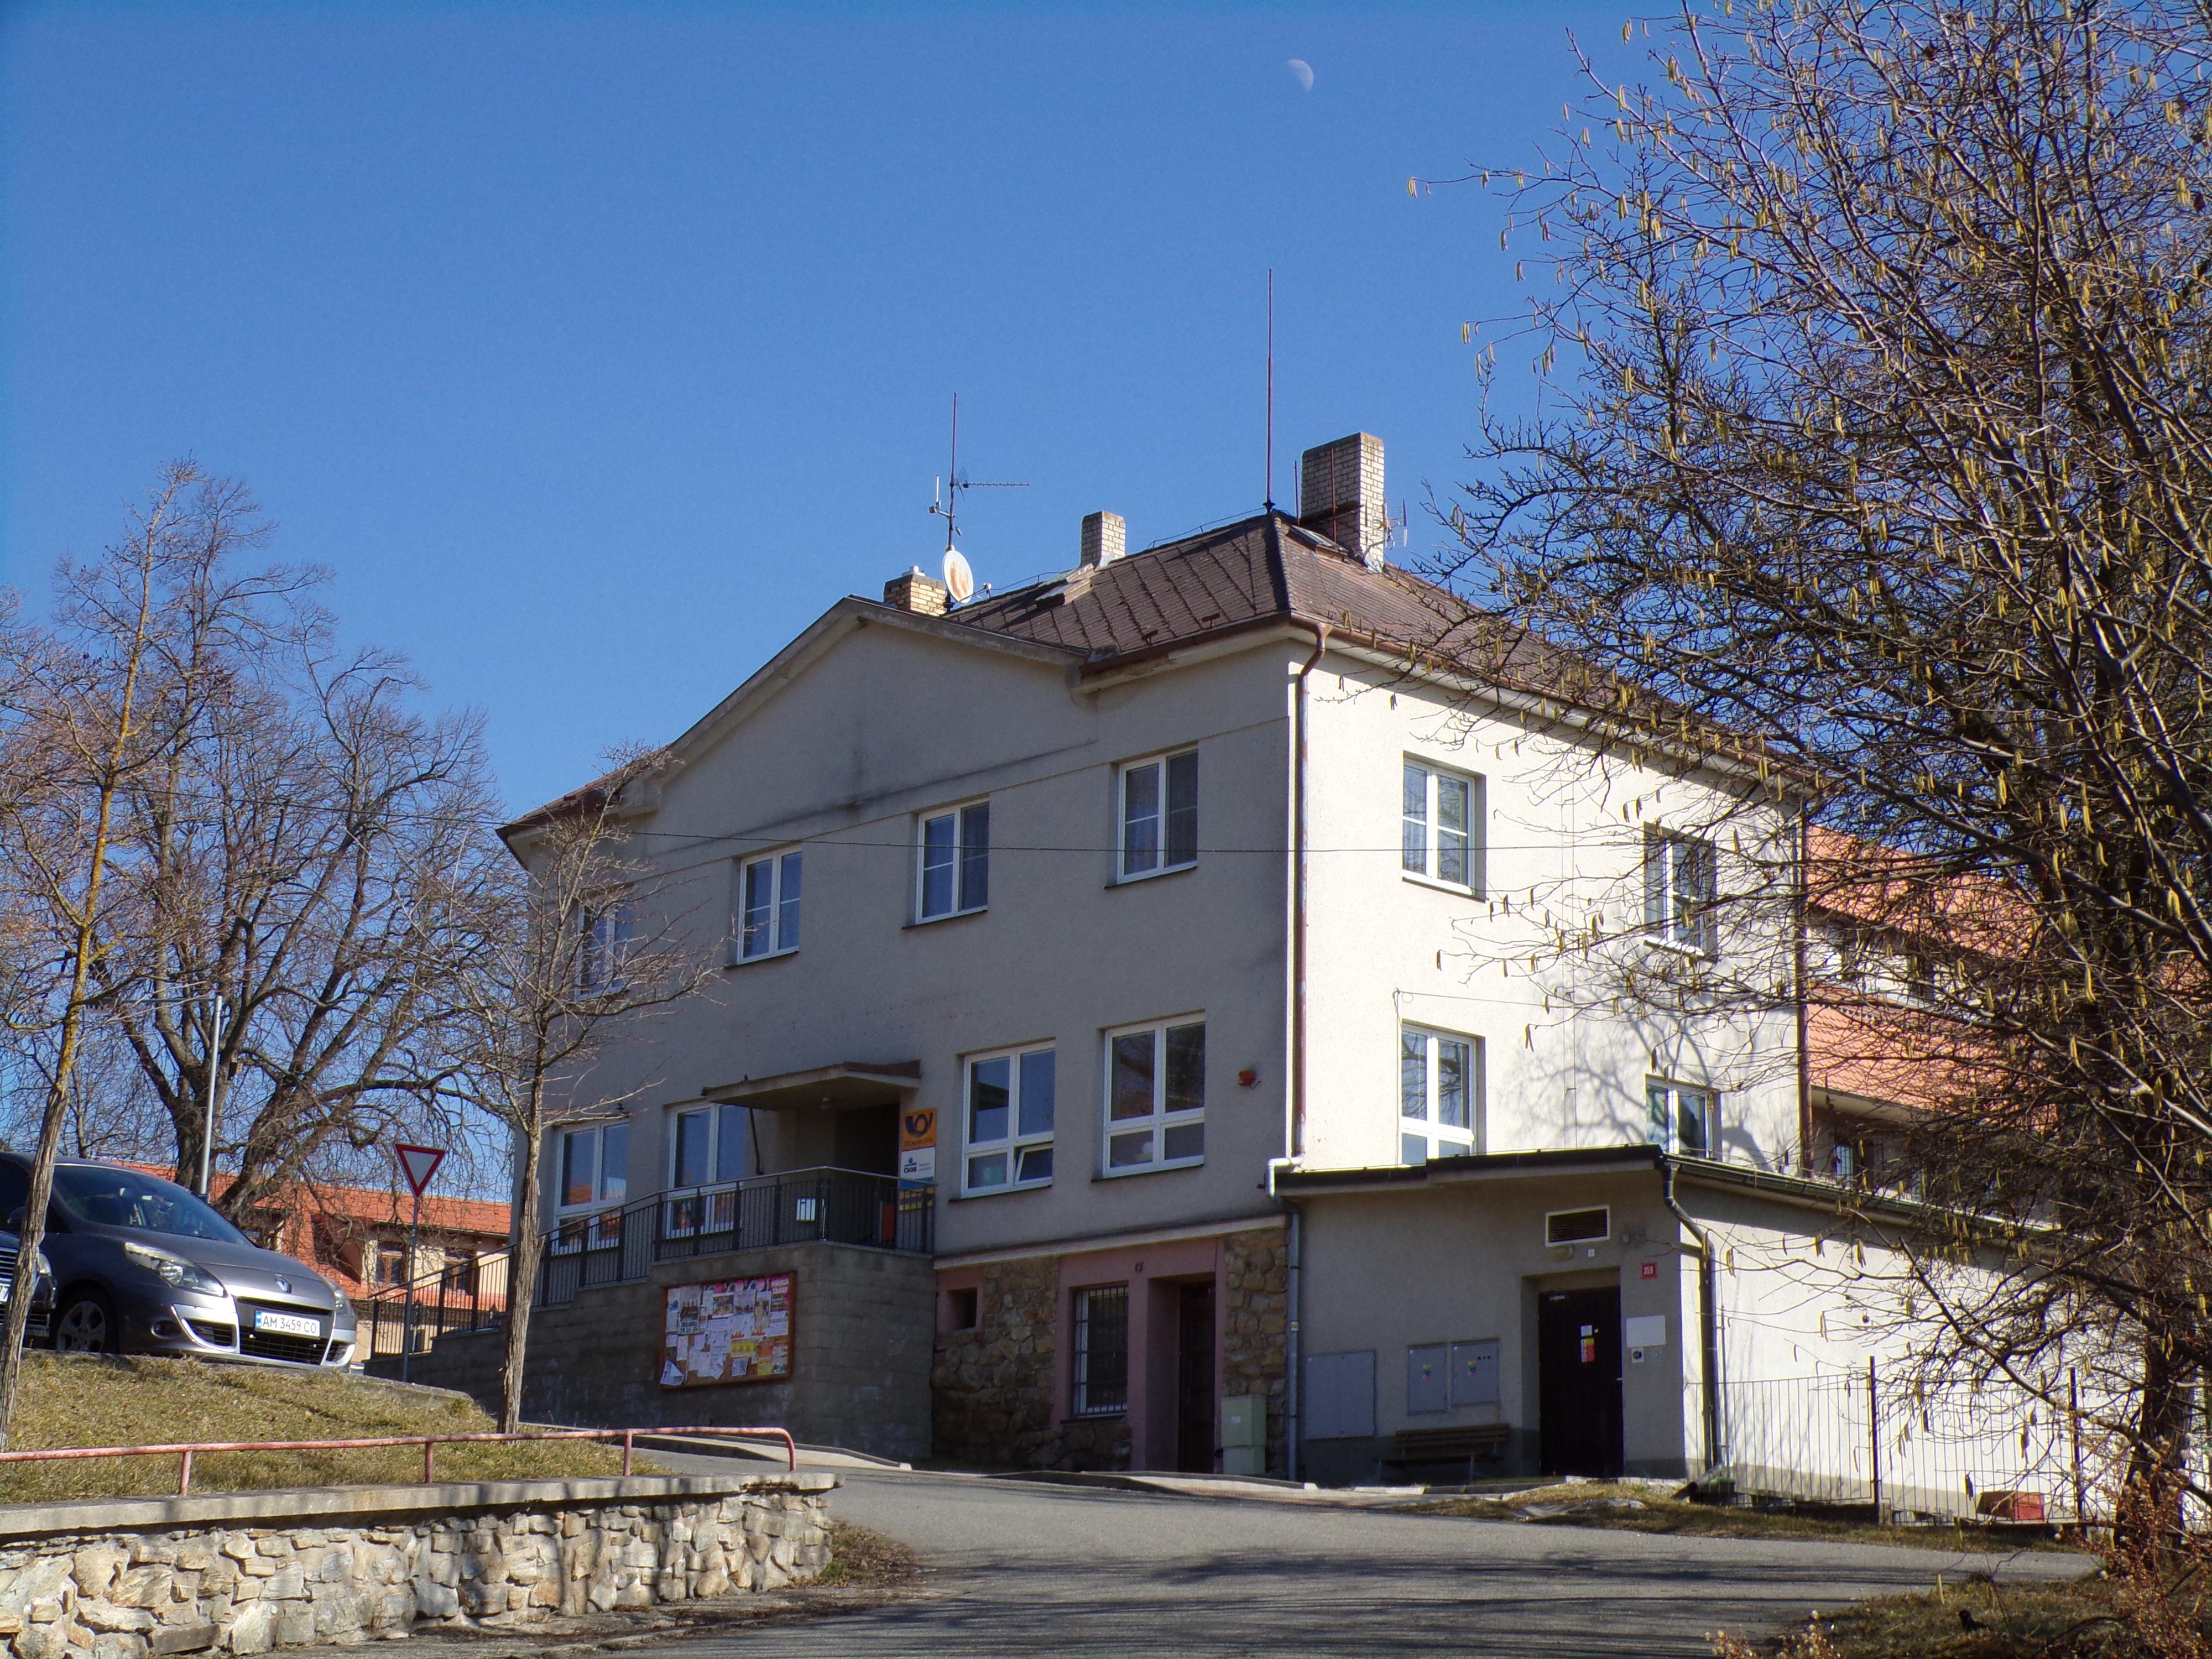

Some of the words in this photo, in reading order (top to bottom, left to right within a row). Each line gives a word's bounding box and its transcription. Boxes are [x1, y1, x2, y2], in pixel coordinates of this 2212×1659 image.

[263, 1316, 278, 1328] AM
[280, 1318, 301, 1331] 3459
[304, 1322, 317, 1334] CO
